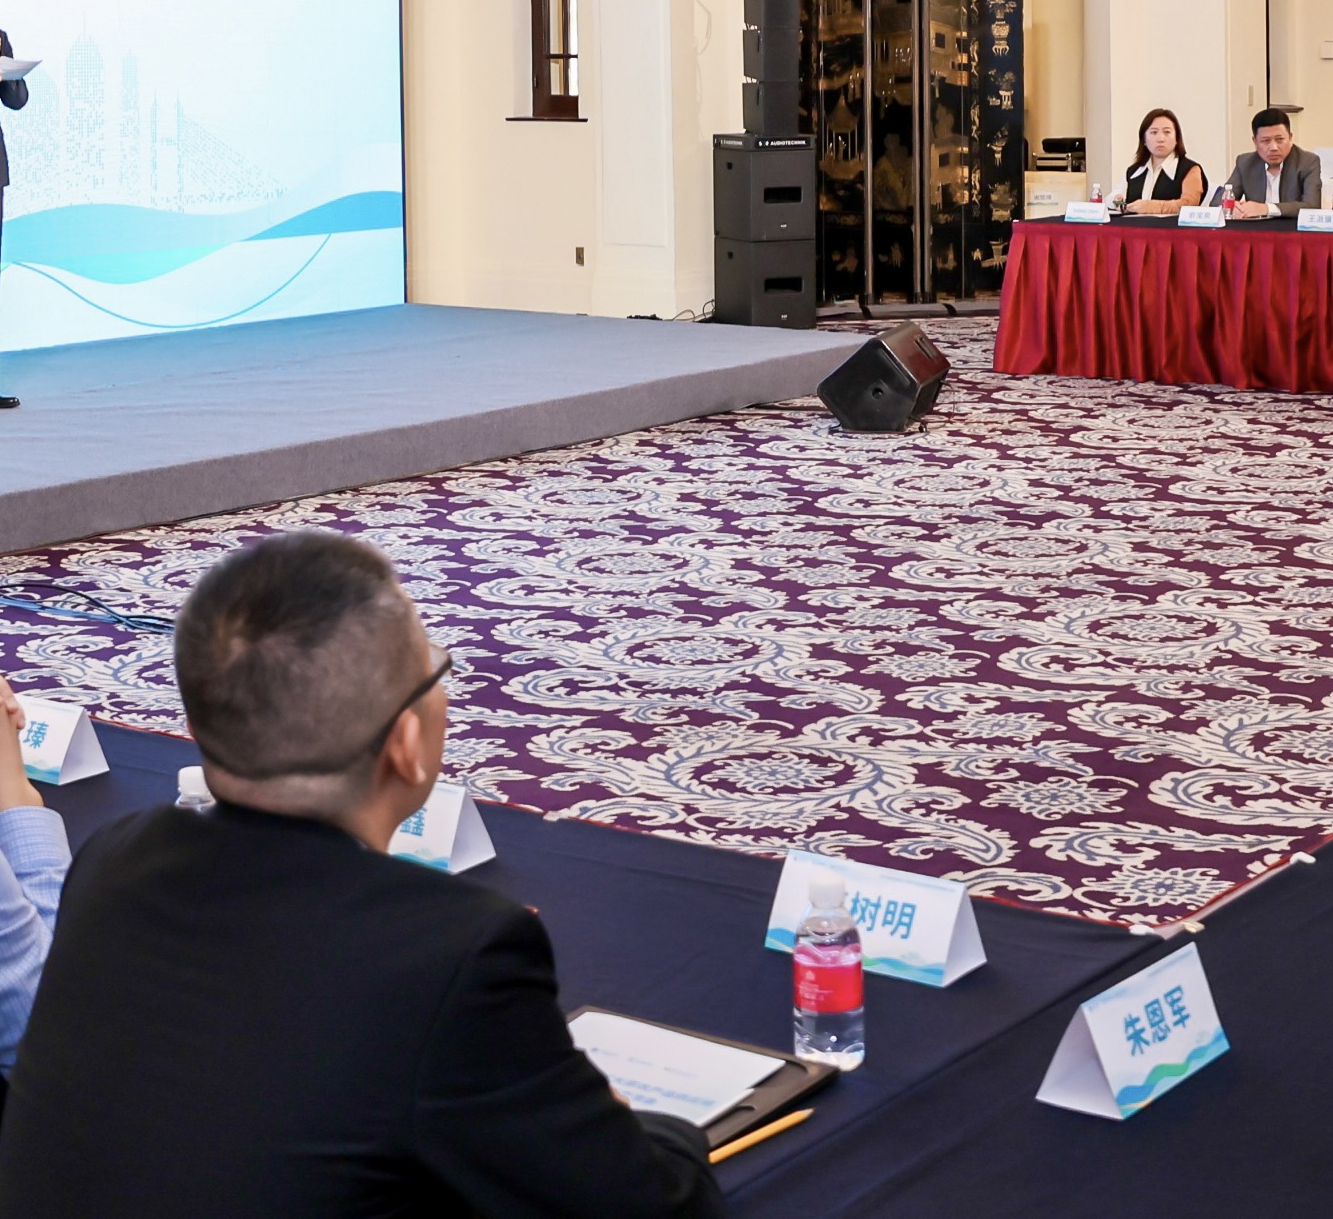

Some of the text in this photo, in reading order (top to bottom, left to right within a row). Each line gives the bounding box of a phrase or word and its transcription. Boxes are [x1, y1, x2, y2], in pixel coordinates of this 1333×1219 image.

[843, 890, 917, 940] 树明
[1123, 984, 1191, 1057] 朱恩军
